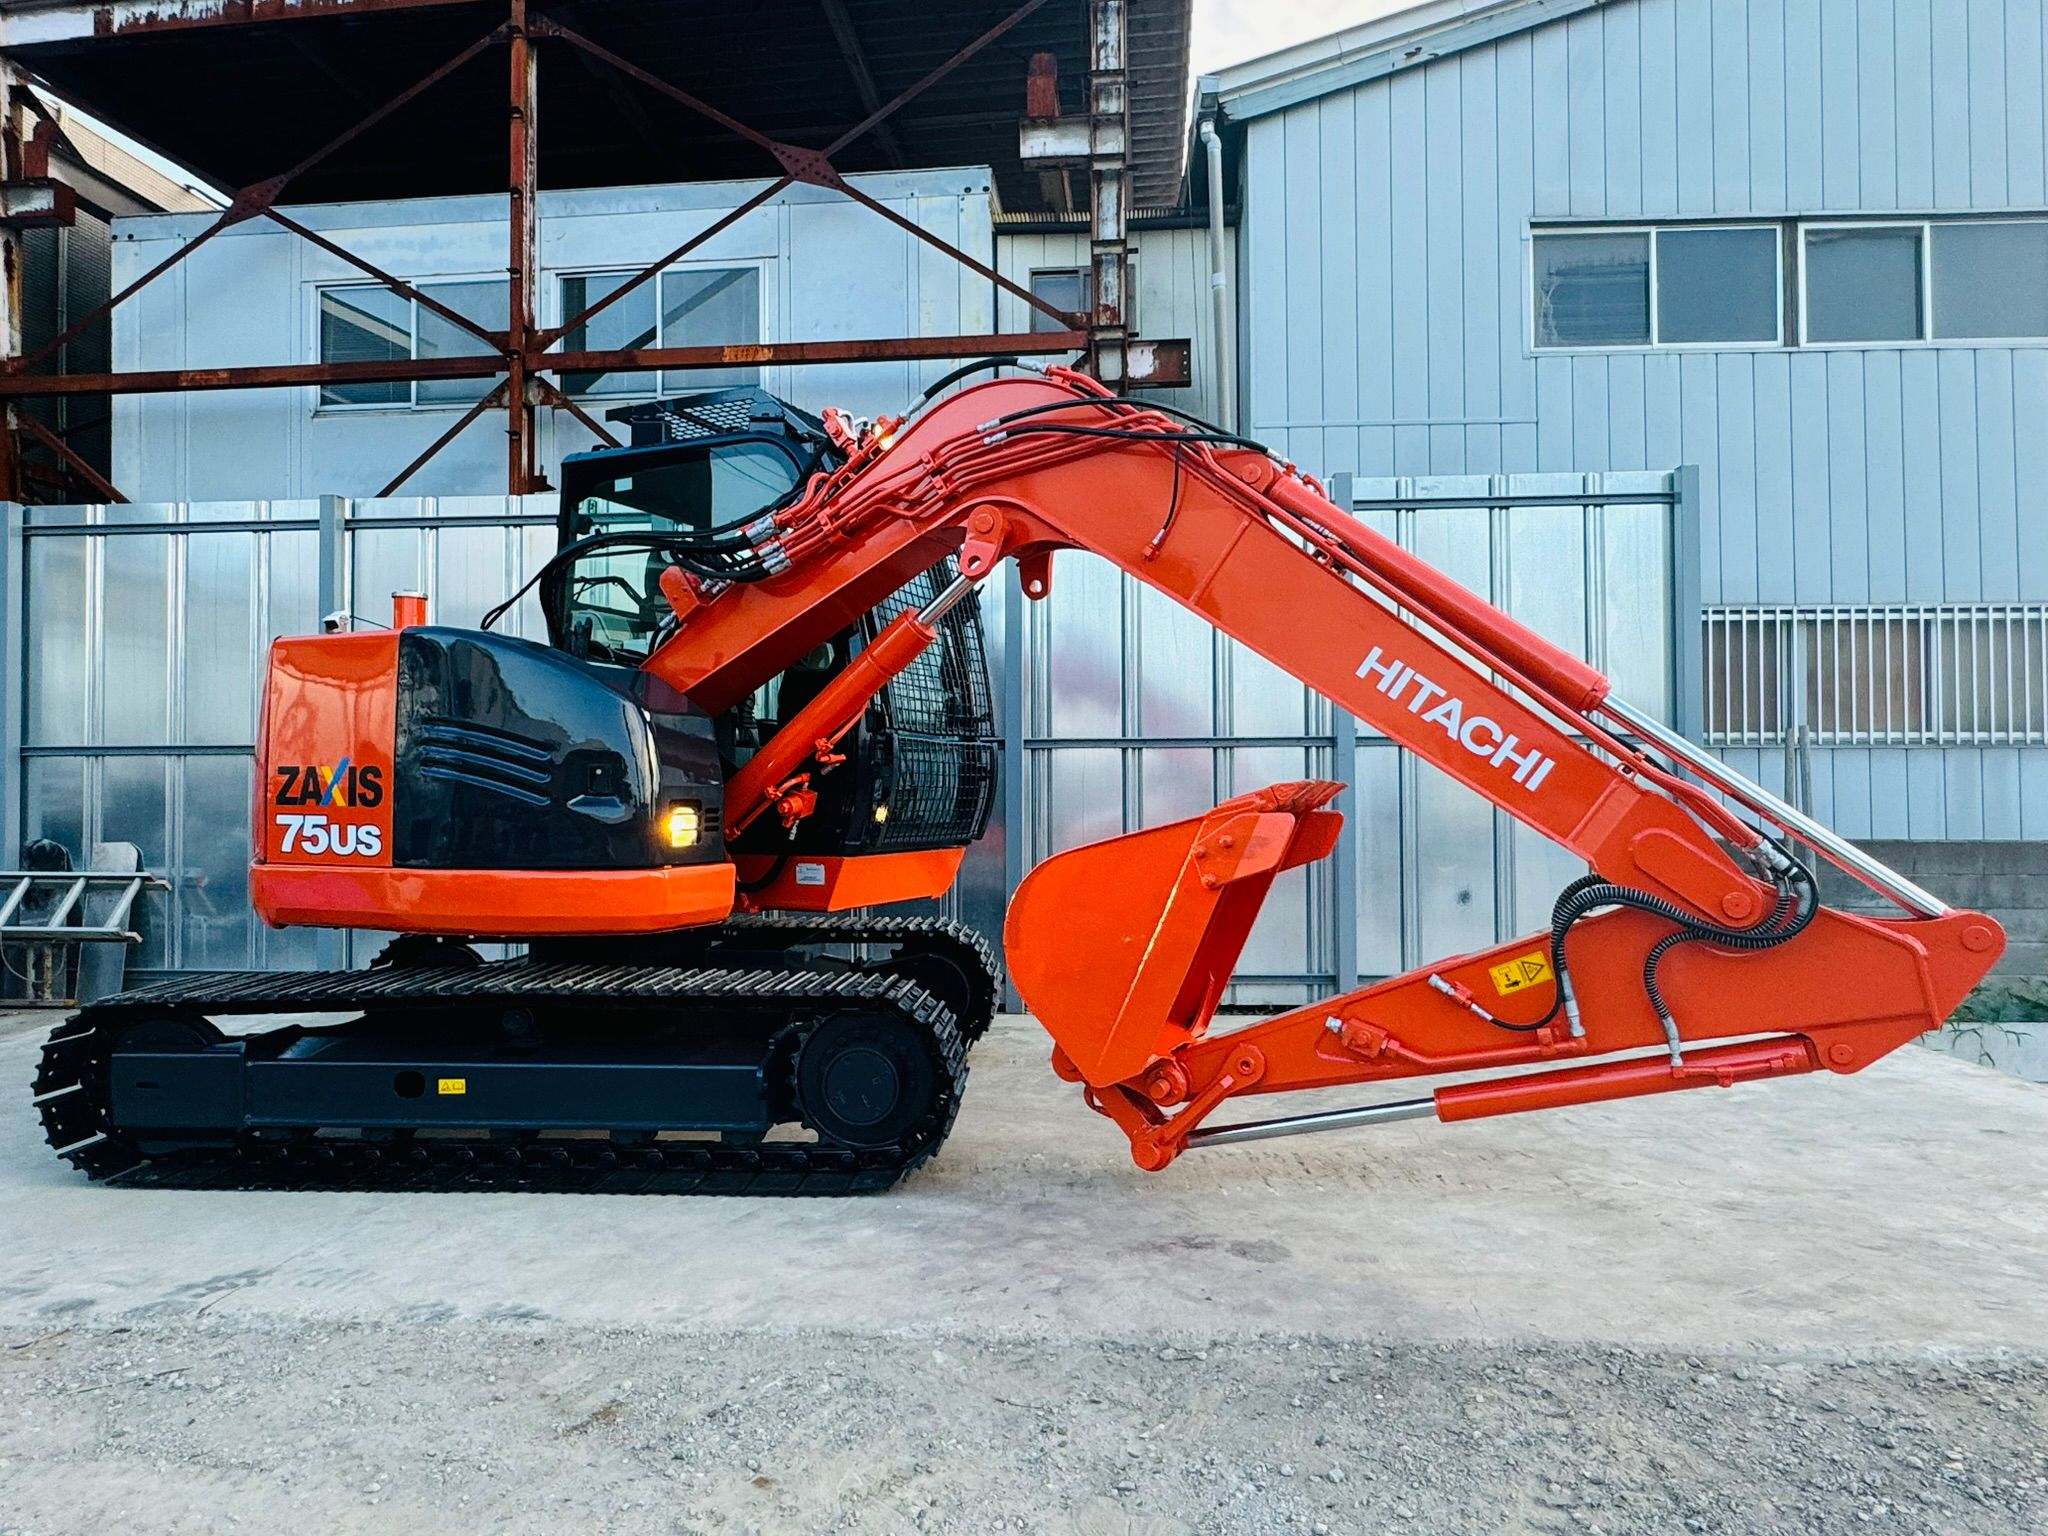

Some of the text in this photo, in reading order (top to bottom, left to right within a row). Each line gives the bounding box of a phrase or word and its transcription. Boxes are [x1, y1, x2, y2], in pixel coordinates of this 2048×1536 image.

[1355, 645, 1556, 792] HITACHI
[276, 757, 383, 807] ZAXIS
[276, 814, 382, 856] 75US
